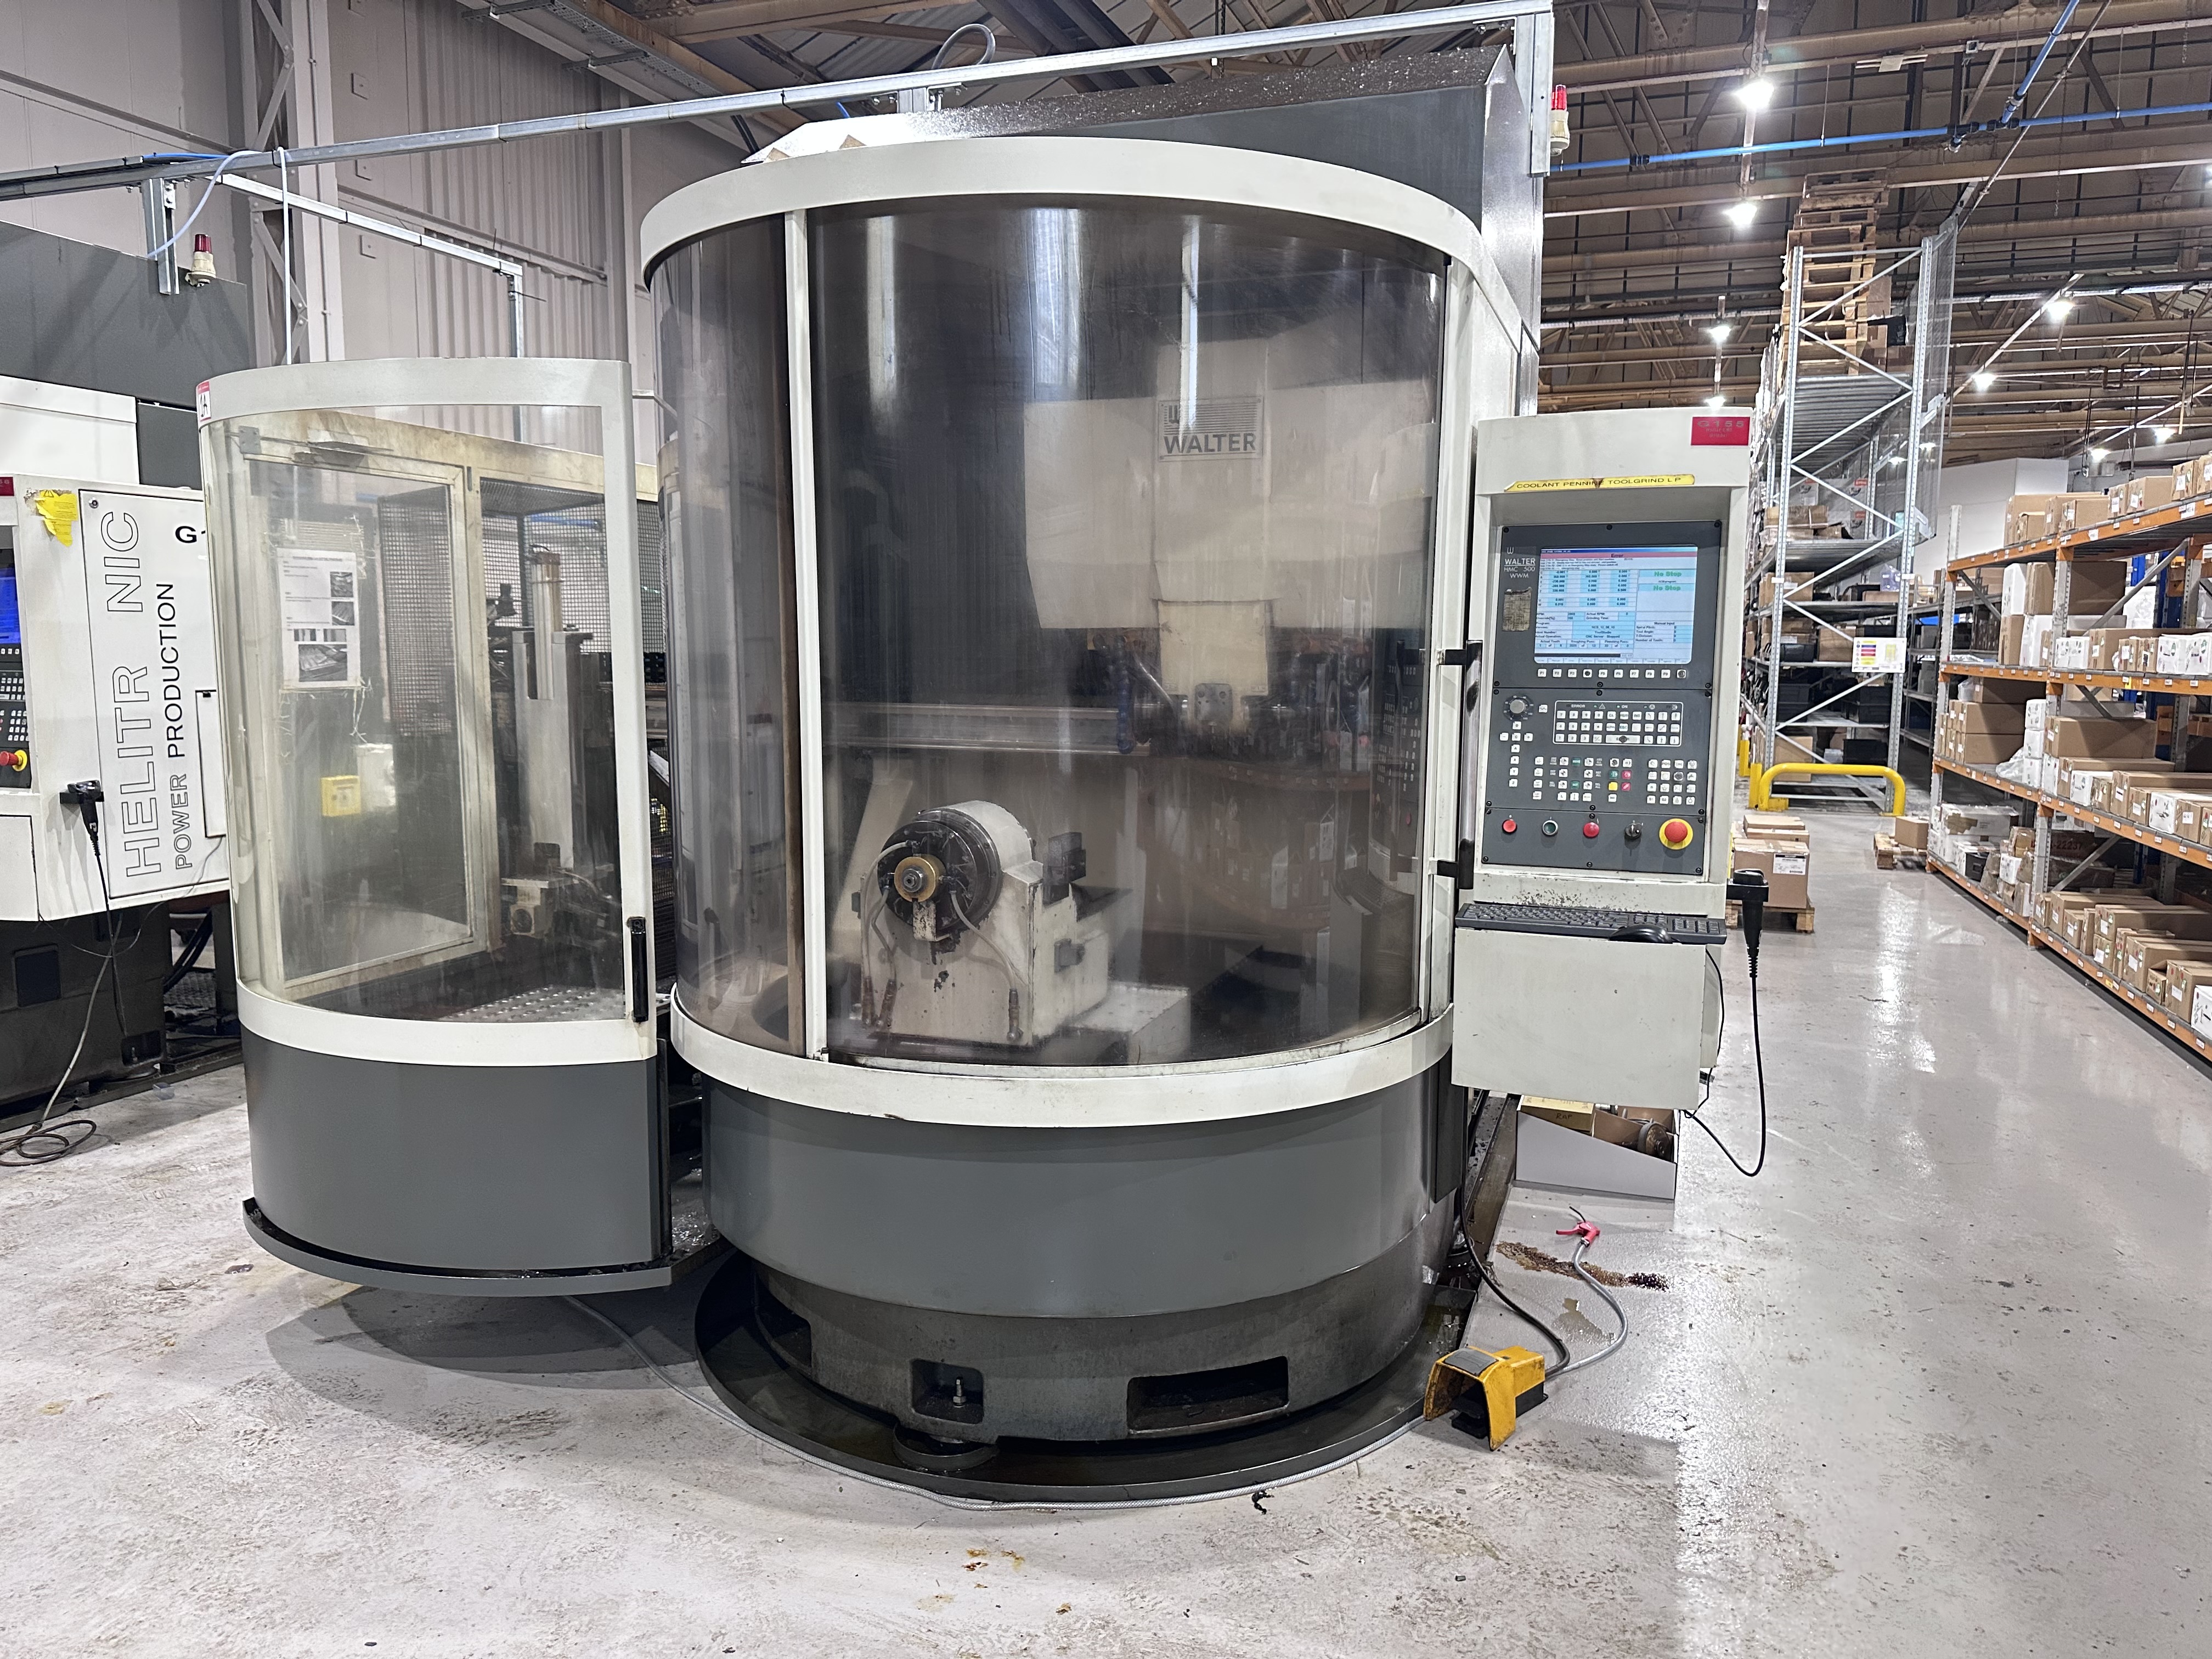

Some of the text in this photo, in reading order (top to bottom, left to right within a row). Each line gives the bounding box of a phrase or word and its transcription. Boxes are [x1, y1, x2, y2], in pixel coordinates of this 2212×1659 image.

[1164, 432, 1257, 454] WALTER
[100, 511, 144, 613] NIC
[1504, 557, 1536, 566] WALTER
[156, 583, 187, 759] PRODUCTION
[112, 664, 162, 878] HELITR
[170, 772, 193, 870] POWER
